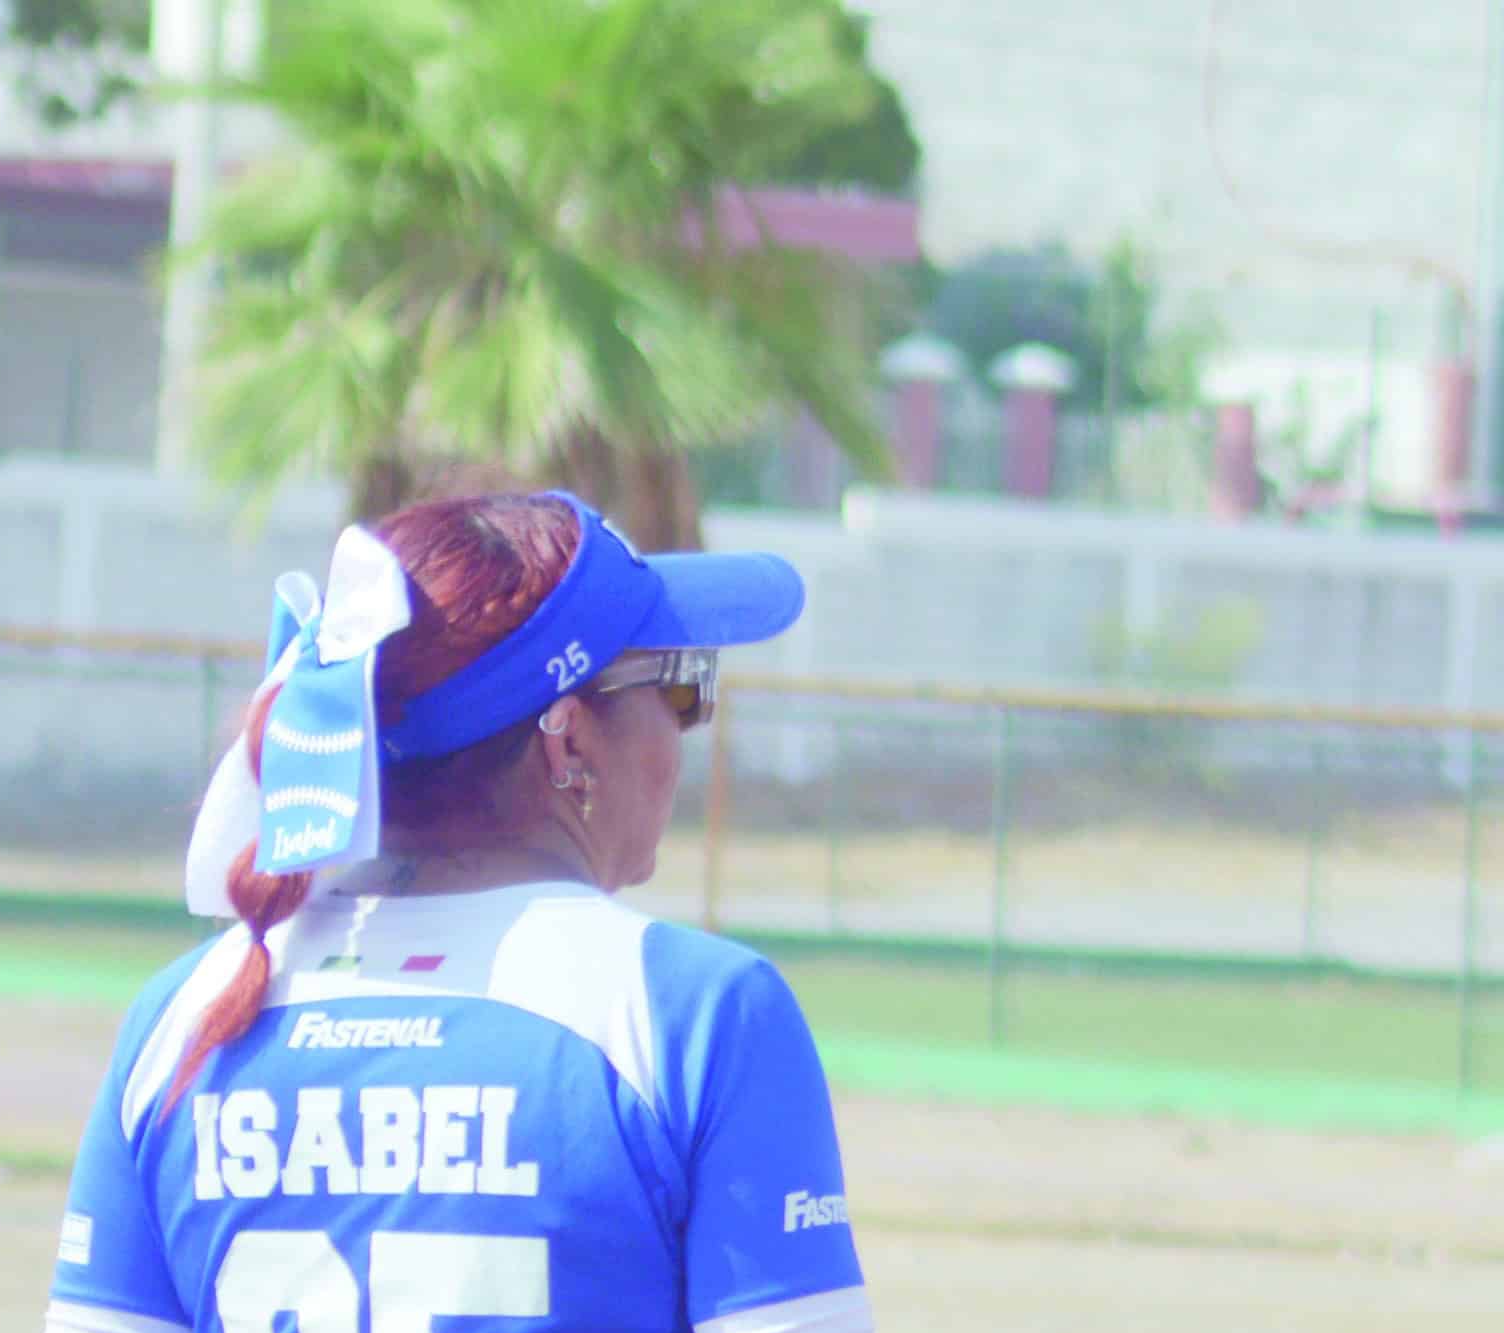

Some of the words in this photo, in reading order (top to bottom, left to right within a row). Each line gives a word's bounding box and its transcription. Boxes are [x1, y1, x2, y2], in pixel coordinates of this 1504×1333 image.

[546, 640, 591, 693] 25
[288, 1011, 444, 1048] FASTENAL
[194, 1086, 538, 1200] ISABEL
